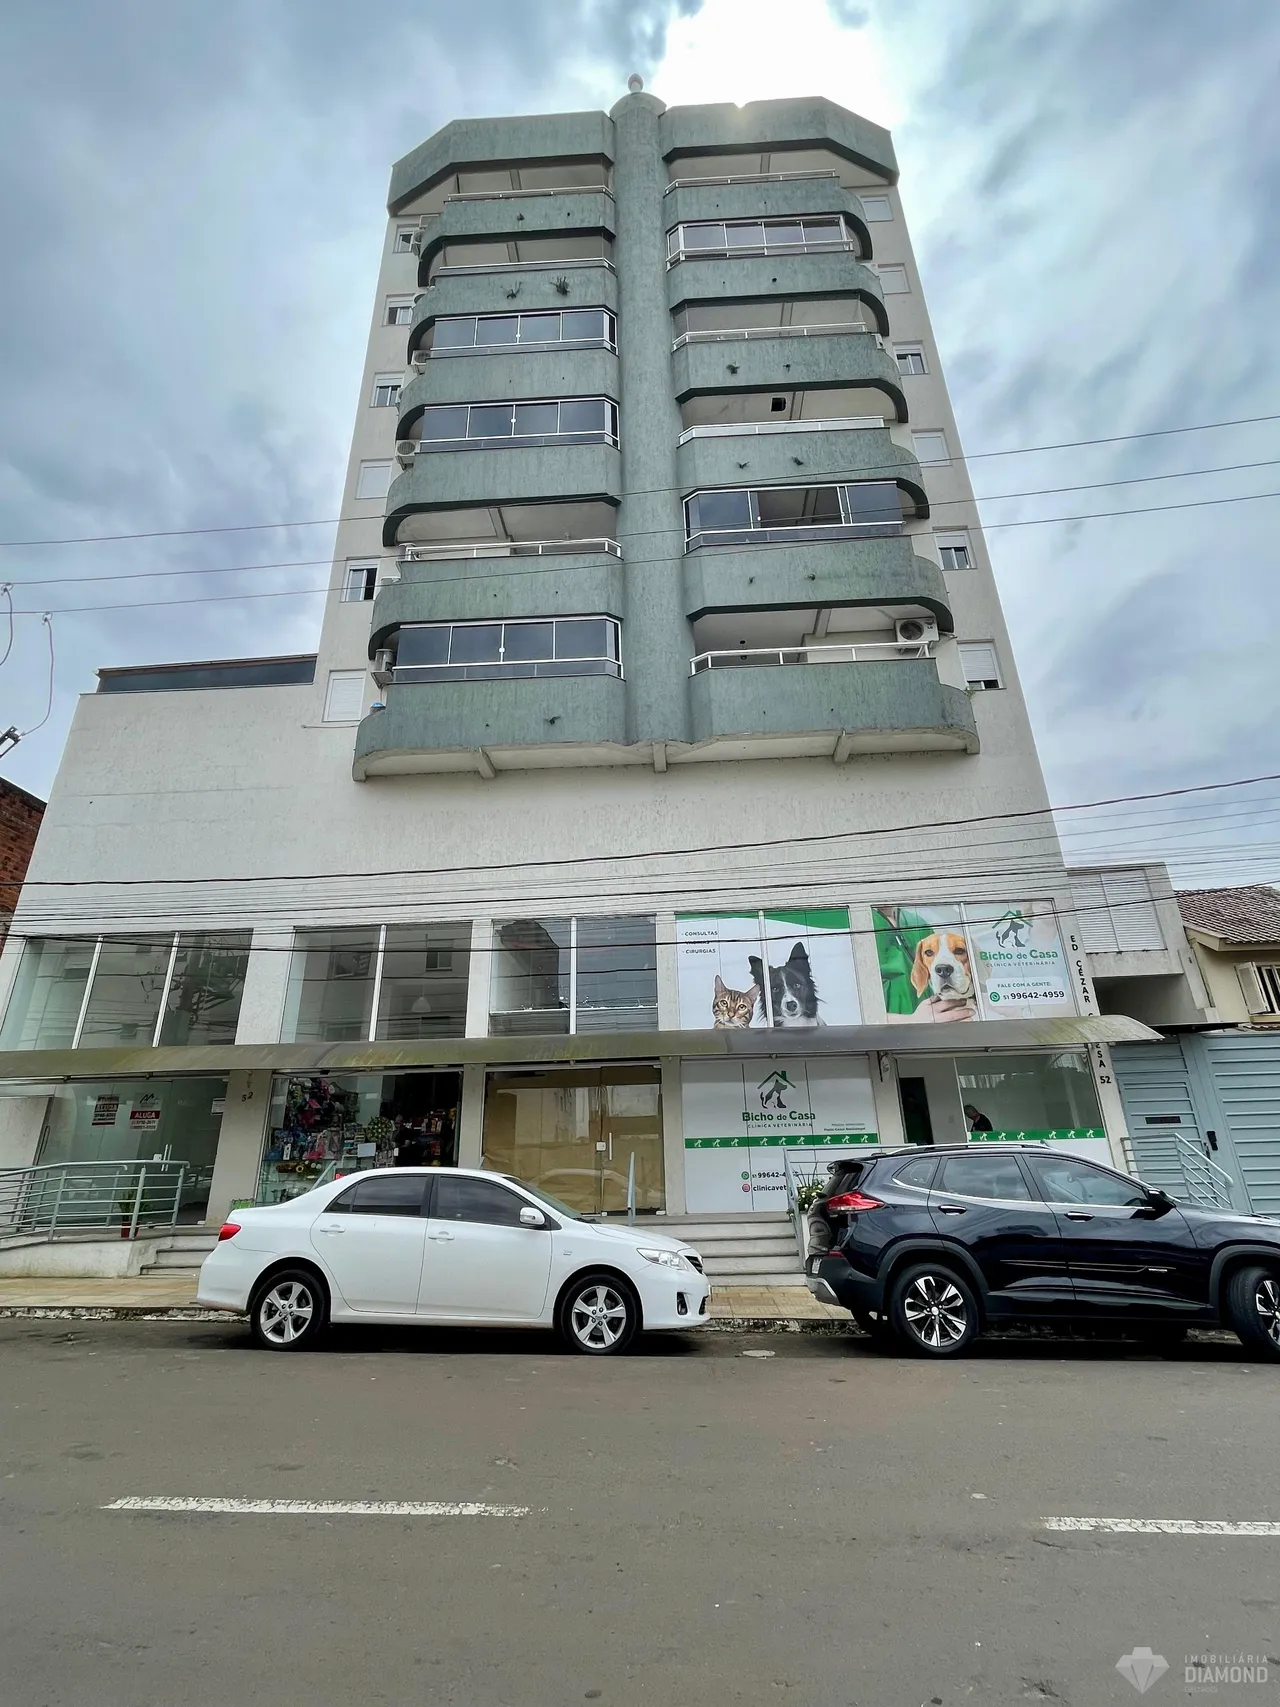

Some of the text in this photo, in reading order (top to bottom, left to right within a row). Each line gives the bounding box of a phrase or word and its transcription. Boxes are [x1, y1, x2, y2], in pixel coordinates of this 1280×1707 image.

[979, 949, 1059, 961] Bicho de Casa
[1010, 990, 1065, 1000] 99642-4959
[1070, 935, 1078, 950] ED
[1100, 1076, 1112, 1085] 52
[241, 1091, 254, 1102] 52
[134, 1111, 156, 1119] ALUGA
[742, 1111, 774, 1121] Bicho
[788, 1110, 816, 1120] Casa
